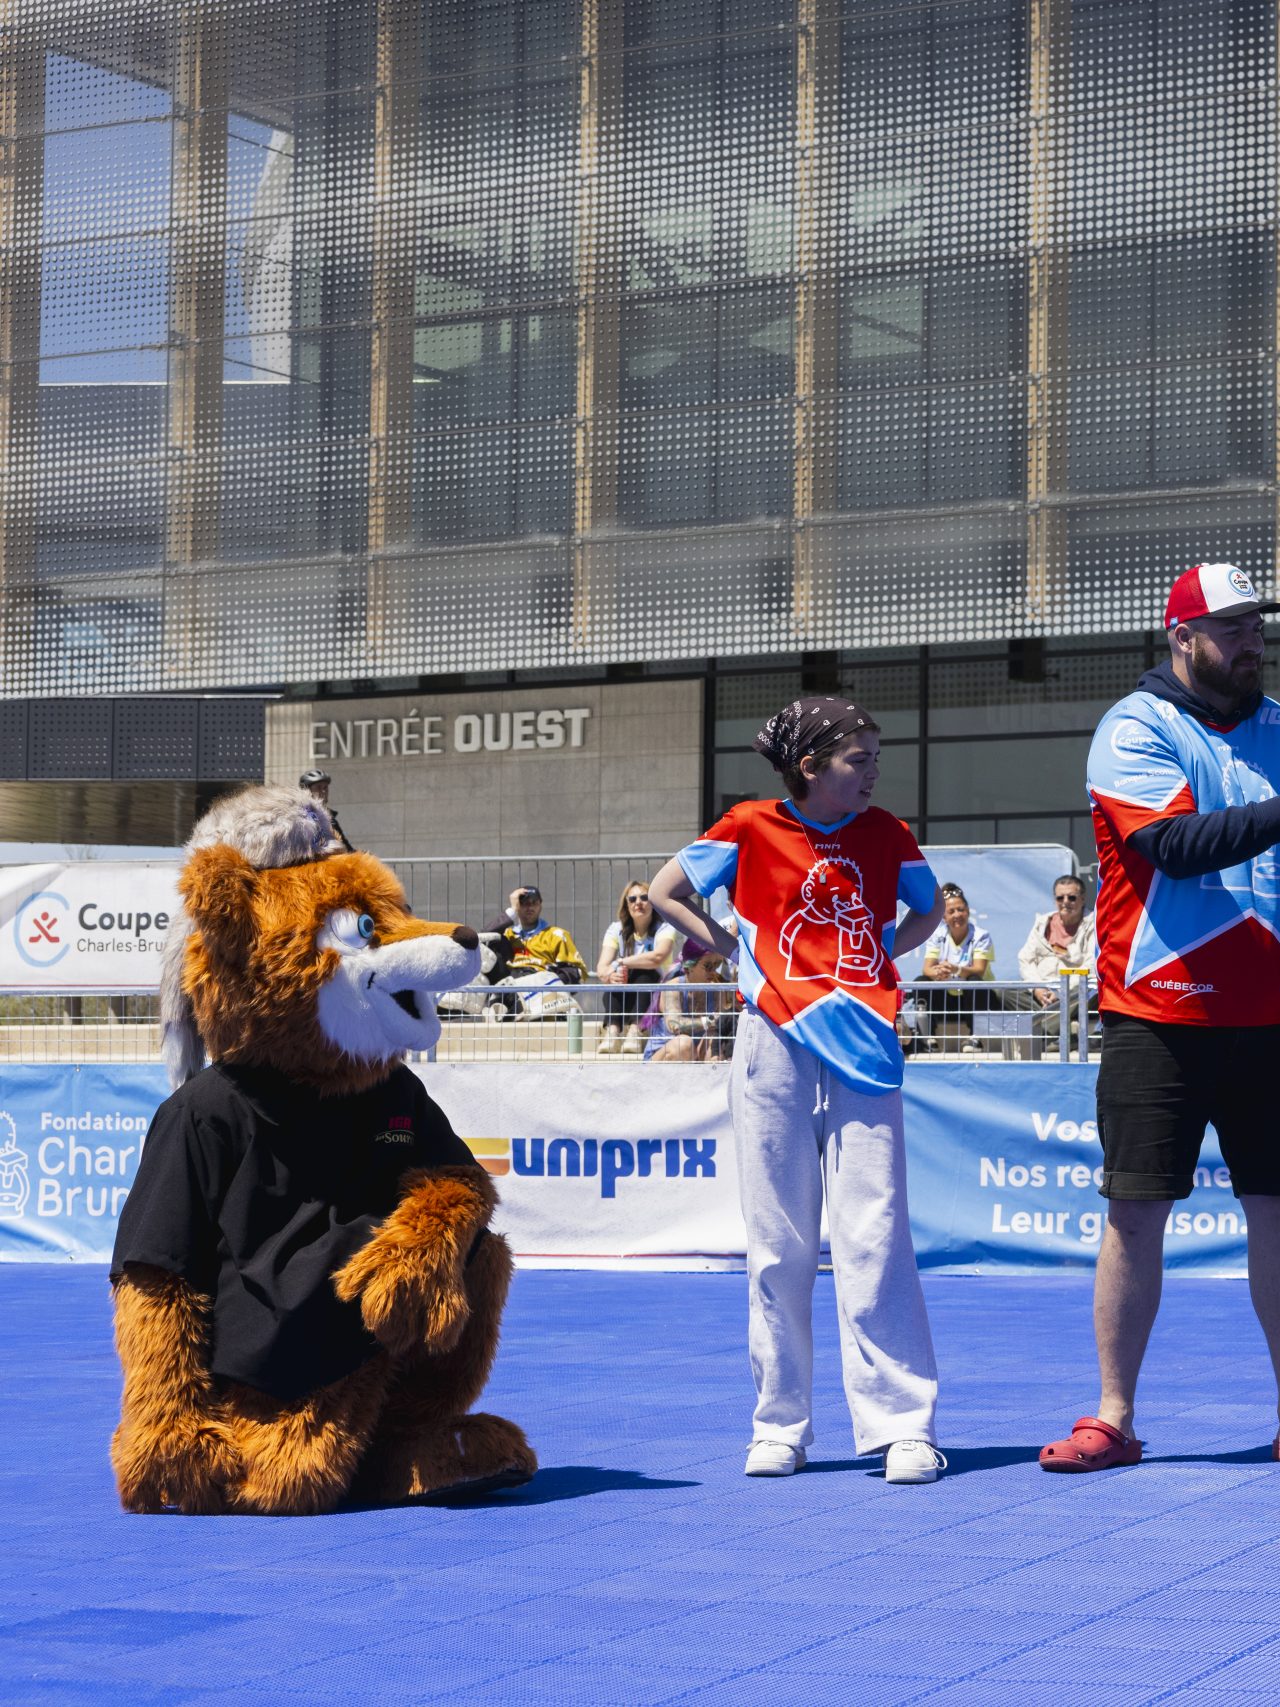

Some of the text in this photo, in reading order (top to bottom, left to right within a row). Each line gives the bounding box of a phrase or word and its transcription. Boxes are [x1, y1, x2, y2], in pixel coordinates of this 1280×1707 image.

[310, 708, 590, 759] ENTRÉE OUEST
[78, 903, 170, 937] Coupe
[77, 939, 163, 953] Charles-Bru
[1150, 980, 1214, 992] QUÉBECOR
[41, 1111, 147, 1131] Fondation
[1031, 1112, 1098, 1143] Vos
[38, 1135, 146, 1176] Charl
[512, 1138, 717, 1199] uniprix
[979, 1157, 1047, 1188] Nos
[37, 1178, 132, 1217] Brun
[992, 1203, 1070, 1234] Leur
